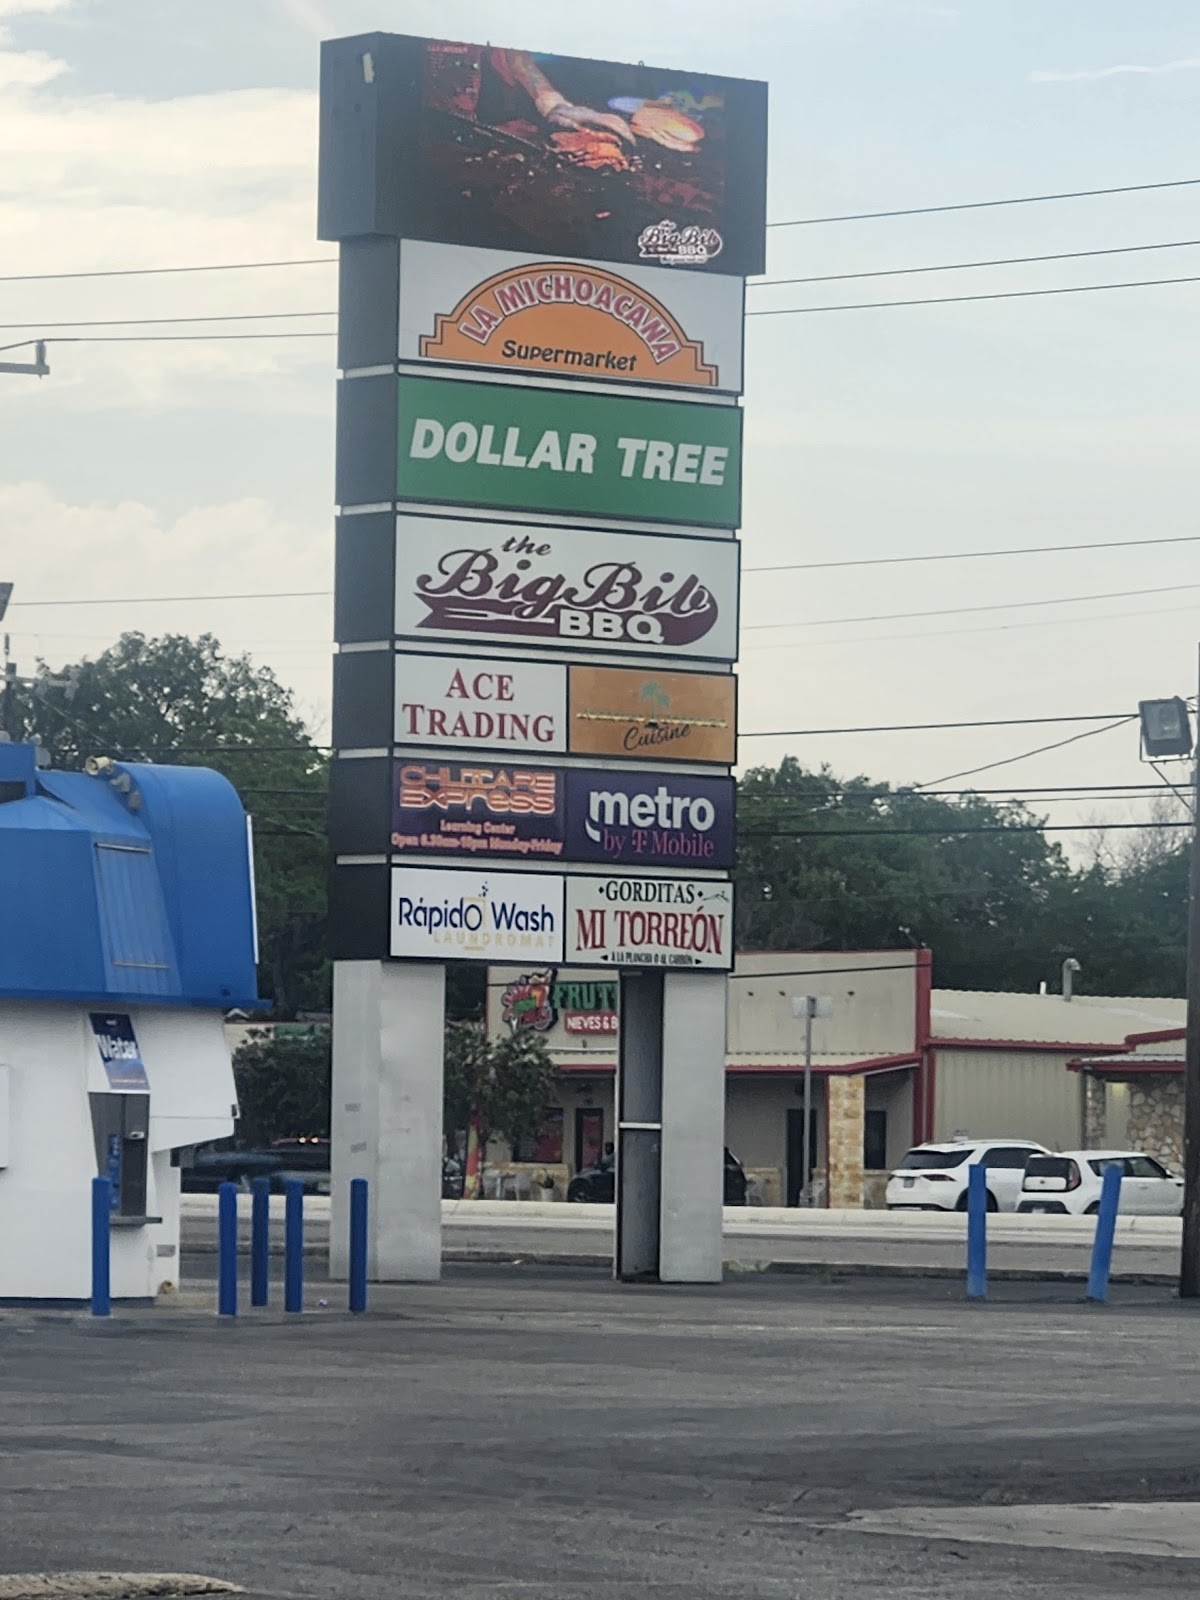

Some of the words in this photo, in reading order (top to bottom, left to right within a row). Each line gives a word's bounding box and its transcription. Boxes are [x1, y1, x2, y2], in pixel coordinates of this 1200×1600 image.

[639, 226, 680, 249] Big
[678, 245, 707, 256] BBQ
[459, 304, 501, 344] LA
[494, 275, 681, 364] MICHOACANA
[502, 339, 637, 371] Supermarket
[410, 418, 597, 474] DOLLAR
[617, 438, 729, 486] TREE
[500, 535, 552, 556] the
[416, 548, 567, 619] Big
[560, 561, 710, 616] Bib
[559, 609, 665, 644] BBQ
[445, 668, 515, 701] ACE
[403, 703, 556, 743] TRADING
[623, 723, 692, 751] Cuisine
[589, 786, 715, 831] metro
[603, 828, 626, 859] by
[605, 880, 695, 904] GORDITAS
[491, 901, 554, 932] Wash
[576, 909, 606, 951] MI
[614, 905, 724, 955] TORREÓN
[433, 932, 554, 947] LAUNDROMAT
